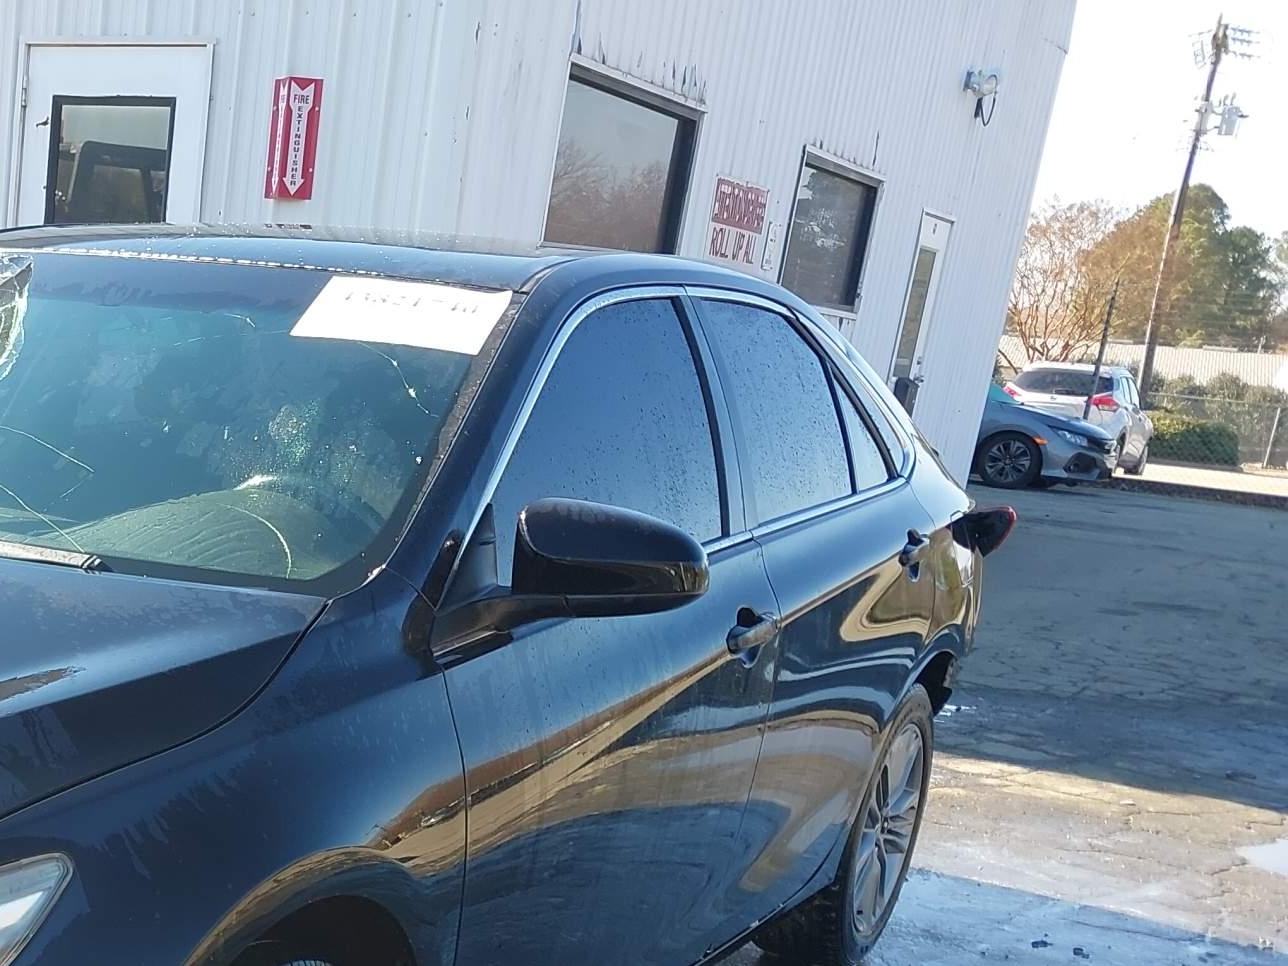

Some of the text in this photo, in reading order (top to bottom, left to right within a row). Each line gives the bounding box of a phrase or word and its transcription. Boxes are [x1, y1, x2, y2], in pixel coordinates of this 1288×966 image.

[293, 94, 310, 105] FIRE
[290, 105, 303, 186] EXTINGUISHER
[709, 227, 729, 259] ROLL
[732, 231, 745, 261] UP
[743, 233, 757, 264] ALL
